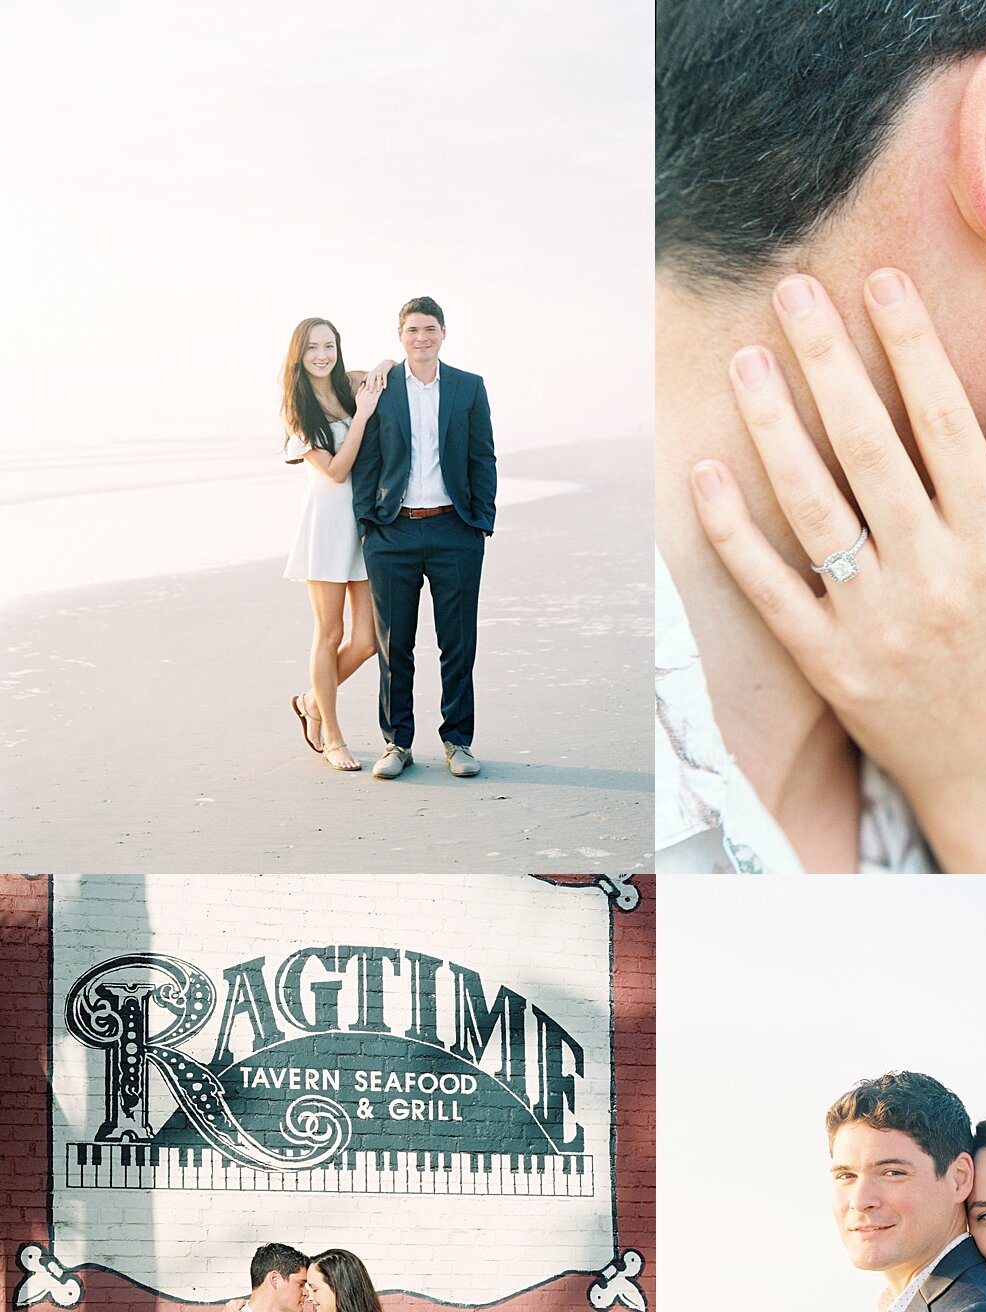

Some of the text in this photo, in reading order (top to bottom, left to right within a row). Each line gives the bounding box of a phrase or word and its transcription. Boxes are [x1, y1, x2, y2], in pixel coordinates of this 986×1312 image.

[64, 945, 584, 1172] RAGTIME
[239, 1066, 477, 1095] TAVERN SEAFOOD
[356, 1097, 463, 1121] & GRILL
